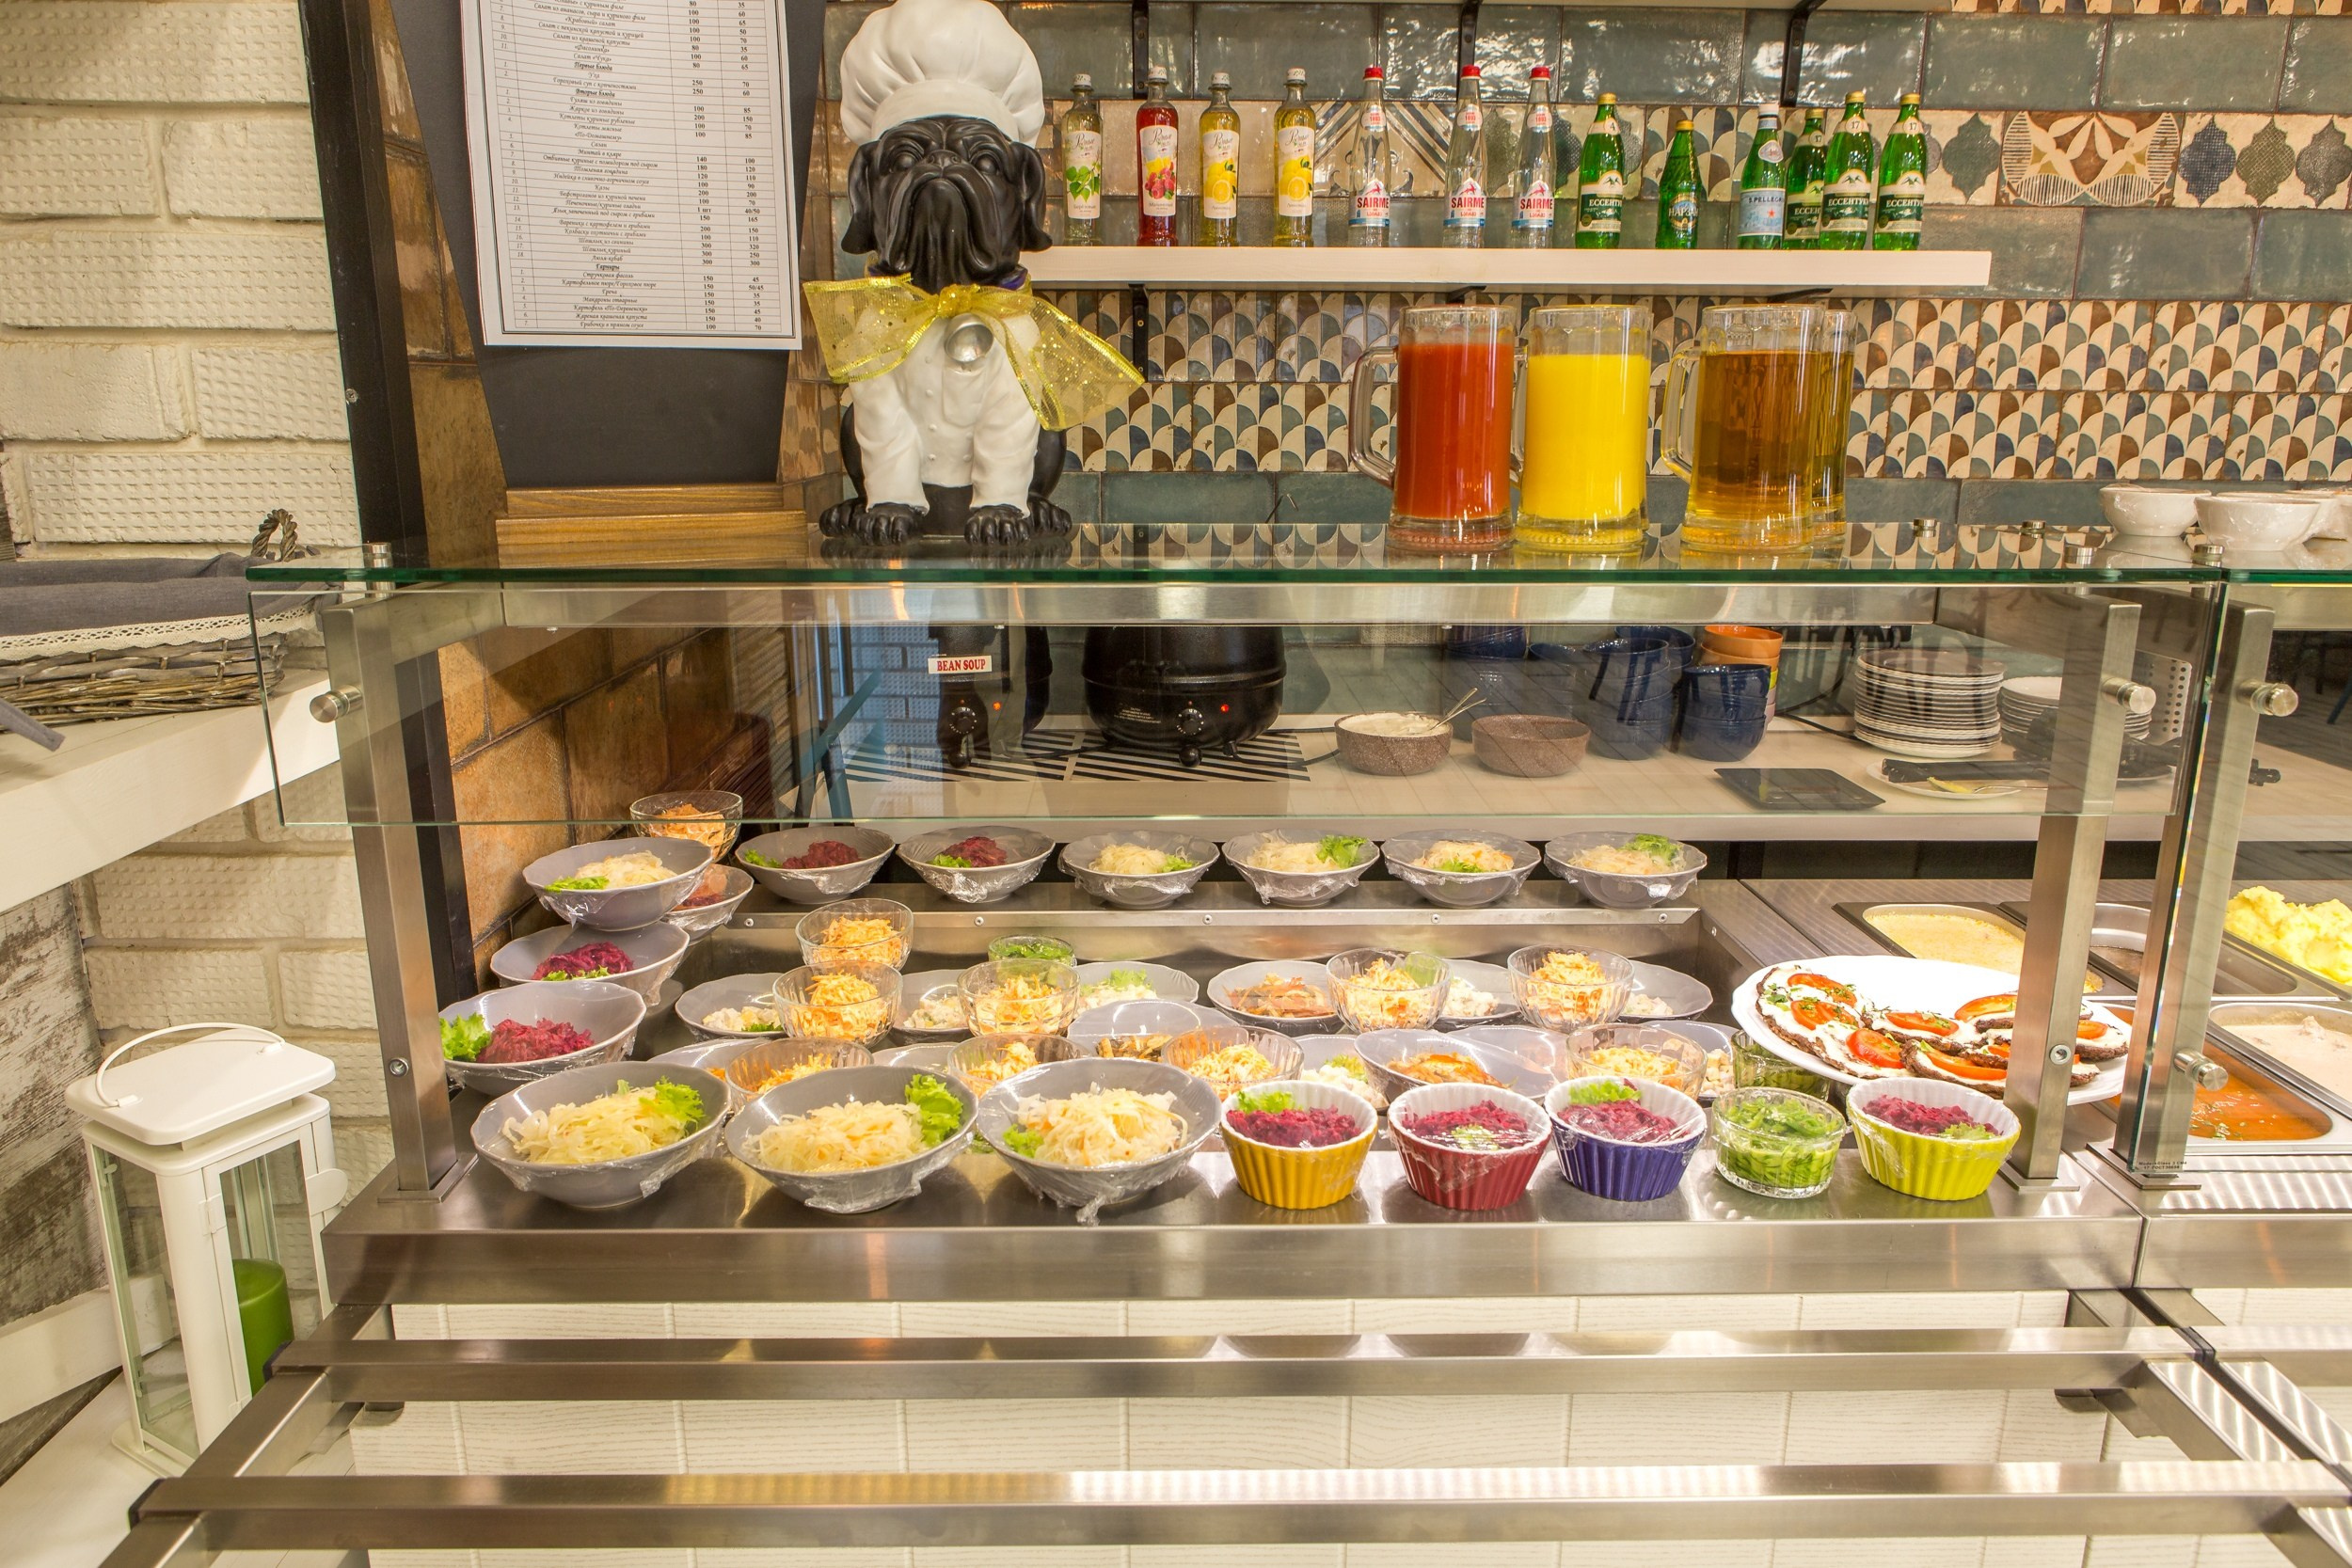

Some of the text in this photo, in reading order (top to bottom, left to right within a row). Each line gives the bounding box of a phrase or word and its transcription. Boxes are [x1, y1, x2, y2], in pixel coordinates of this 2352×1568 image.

[1609, 122, 1616, 131] 4
[1851, 121, 1861, 129] 17
[1909, 122, 1918, 131] 17
[1357, 197, 1389, 208] SAIRME
[1451, 197, 1484, 208] SAIRME
[1520, 198, 1553, 210] SAIRME
[937, 659, 986, 671] BEAN SOUP
